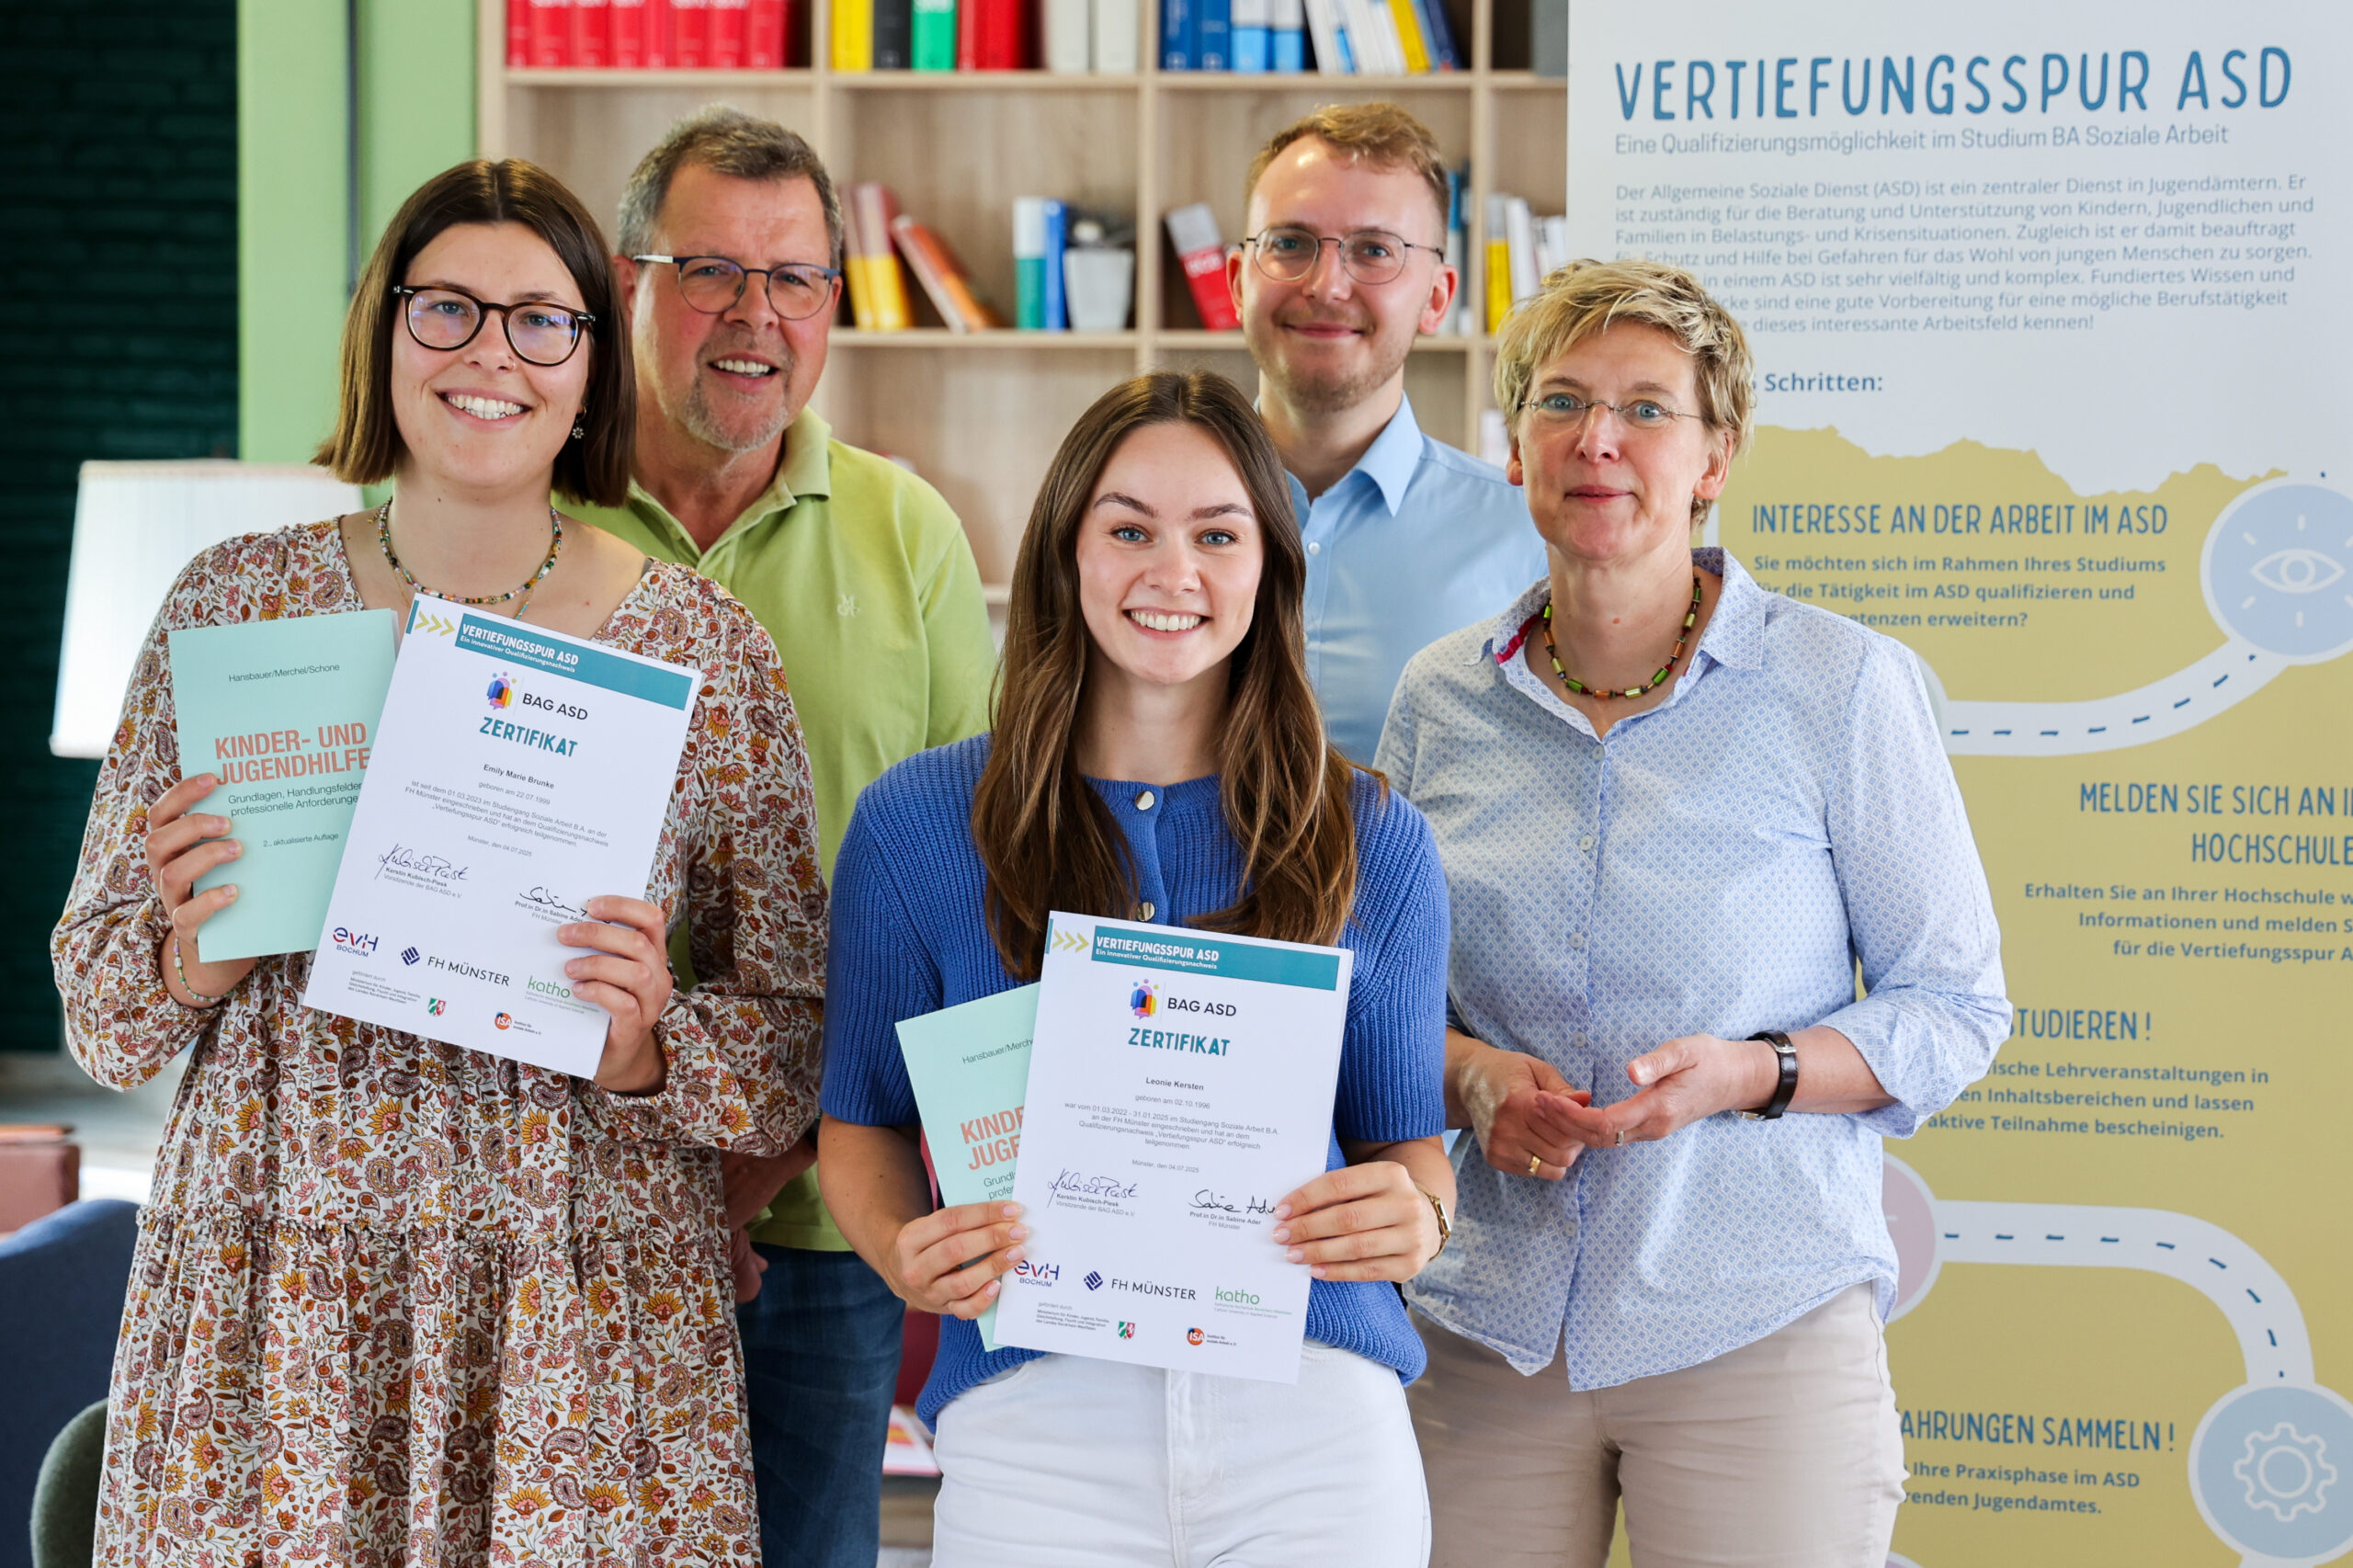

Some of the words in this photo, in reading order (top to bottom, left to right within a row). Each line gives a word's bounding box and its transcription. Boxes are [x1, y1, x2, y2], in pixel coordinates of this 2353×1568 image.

[1615, 51, 2149, 120] VERTIEFUNGSSPUR
[2177, 47, 2292, 110] ASD
[1616, 134, 1656, 153] Eine
[1662, 130, 1925, 156] Qualifizierungsmöglichkeit
[1932, 130, 1955, 148] im
[1961, 127, 2046, 148] Studium
[2052, 125, 2080, 146] BA
[2086, 124, 2160, 146] Soziale
[2165, 123, 2229, 144] Arbeit
[1616, 185, 1645, 200] Der
[1651, 184, 1745, 203] Allgemeine
[1750, 183, 1808, 199] Soziale
[1814, 182, 1868, 197] Dienst
[1873, 181, 1920, 199] (ASD)
[1926, 182, 1944, 195] ist
[1950, 183, 1976, 195] ein
[1983, 180, 2060, 195] zentraler
[2066, 177, 2121, 193] Dienst
[2128, 180, 2143, 191] in
[2147, 176, 2281, 196] Jugendämtern.
[2288, 174, 2306, 190] Er
[1765, 372, 1883, 391] Schritten:
[1753, 505, 1881, 533] INTERESSE
[1891, 505, 1925, 533] AN
[1934, 505, 1981, 534] DER
[1990, 505, 2075, 534] ARBEIT
[2085, 505, 2108, 533] IM
[2118, 505, 2167, 533] ASD
[1755, 556, 1779, 570] Sie
[1786, 556, 1866, 570] möchten
[1872, 556, 1906, 571] sich
[1914, 556, 1936, 570] im
[1942, 557, 2018, 571] Rahmen
[2025, 556, 2071, 571] Ihres
[2077, 557, 2165, 572] Studiums
[1786, 583, 1813, 597] die
[1819, 583, 1899, 602] Tätigkeit
[1905, 584, 1927, 597] im
[1933, 584, 1970, 598] ASD
[1975, 584, 2092, 602] qualifizieren
[2098, 585, 2134, 599] und
[463, 623, 555, 659] VERTIEFUNGSSPUR
[556, 651, 578, 665] ASD
[471, 639, 504, 652] innovativer
[505, 648, 574, 673] Qualifizierungsnachweis
[228, 665, 339, 682] Hansbauer/Merchel/Schone
[522, 693, 553, 710] BAG
[556, 703, 587, 720] ASD
[215, 730, 311, 759] KINDER-
[318, 722, 366, 747] UND
[479, 717, 577, 756] ZERTIFIKAT
[217, 747, 369, 786] JUGENDHILFE
[483, 764, 504, 776] Emily
[506, 770, 526, 780] Marie
[528, 776, 553, 789] Brunke
[228, 791, 284, 803] Grundlagen,
[287, 781, 362, 797] Handlungsfelder
[2080, 783, 2177, 812] MELDEN
[2187, 784, 2222, 813] SIE
[2233, 786, 2289, 815] SICH
[2298, 787, 2334, 815] AN
[231, 801, 293, 818] professionelle
[2192, 833, 2353, 865] HOCHSCHULE
[2025, 883, 2103, 899] Erhalten
[2110, 885, 2136, 900] Sie
[2143, 889, 2165, 900] an
[2172, 886, 2218, 901] Ihrer
[2224, 888, 2335, 904] Hochschule
[2079, 912, 2216, 929] Informationen
[2223, 915, 2258, 930] und
[2266, 916, 2336, 932] melden
[335, 944, 369, 958] BOCHUM
[1097, 937, 1194, 959] VERTIEFUNGSSPUR
[1196, 949, 1219, 961] ASD
[1107, 950, 1142, 960] innovativer
[1142, 954, 1217, 969] Qualifizierungsnachweis
[2113, 940, 2141, 955] für
[2146, 941, 2175, 956] die
[2180, 943, 2335, 963] Vertiefungsspur
[427, 956, 445, 969] FH
[448, 961, 509, 986] MÜNSTER
[527, 975, 571, 999] katho
[1167, 997, 1199, 1012] BAG
[1203, 1002, 1236, 1016] ASD
[497, 1016, 512, 1028] ISA
[2146, 1012, 2150, 1040] !
[1128, 1028, 1230, 1056] ZERTIFIKAT
[1145, 1077, 1171, 1086] Leonie
[1174, 1081, 1203, 1090] Kersten
[2046, 1062, 2245, 1085] Lehrveranstaltungen
[2252, 1069, 2268, 1083] in
[1988, 1088, 2145, 1107] Inhaltsbereichen
[2153, 1094, 2188, 1108] und
[2195, 1095, 2254, 1110] lassen
[1927, 1113, 1984, 1130] aktive
[1991, 1116, 2088, 1132] Teilnahme
[2095, 1119, 2223, 1141] bescheinigen.
[1019, 1278, 1052, 1287] BOCHUM
[1111, 1278, 1128, 1290] FH
[1132, 1282, 1195, 1300] MÜNSTER
[1216, 1286, 1259, 1305] katho
[1188, 1332, 1204, 1342] ISA
[1899, 1409, 2034, 1444] AHRUNGEN
[2043, 1417, 2159, 1450] SAMMELN
[2169, 1423, 2173, 1451] !
[1914, 1461, 1949, 1478] Ihre
[1956, 1463, 2068, 1485] Praxisphase
[2075, 1470, 2097, 1485] im
[2103, 1471, 2140, 1487] ASD
[1972, 1493, 2101, 1513] Jugendamtes.
